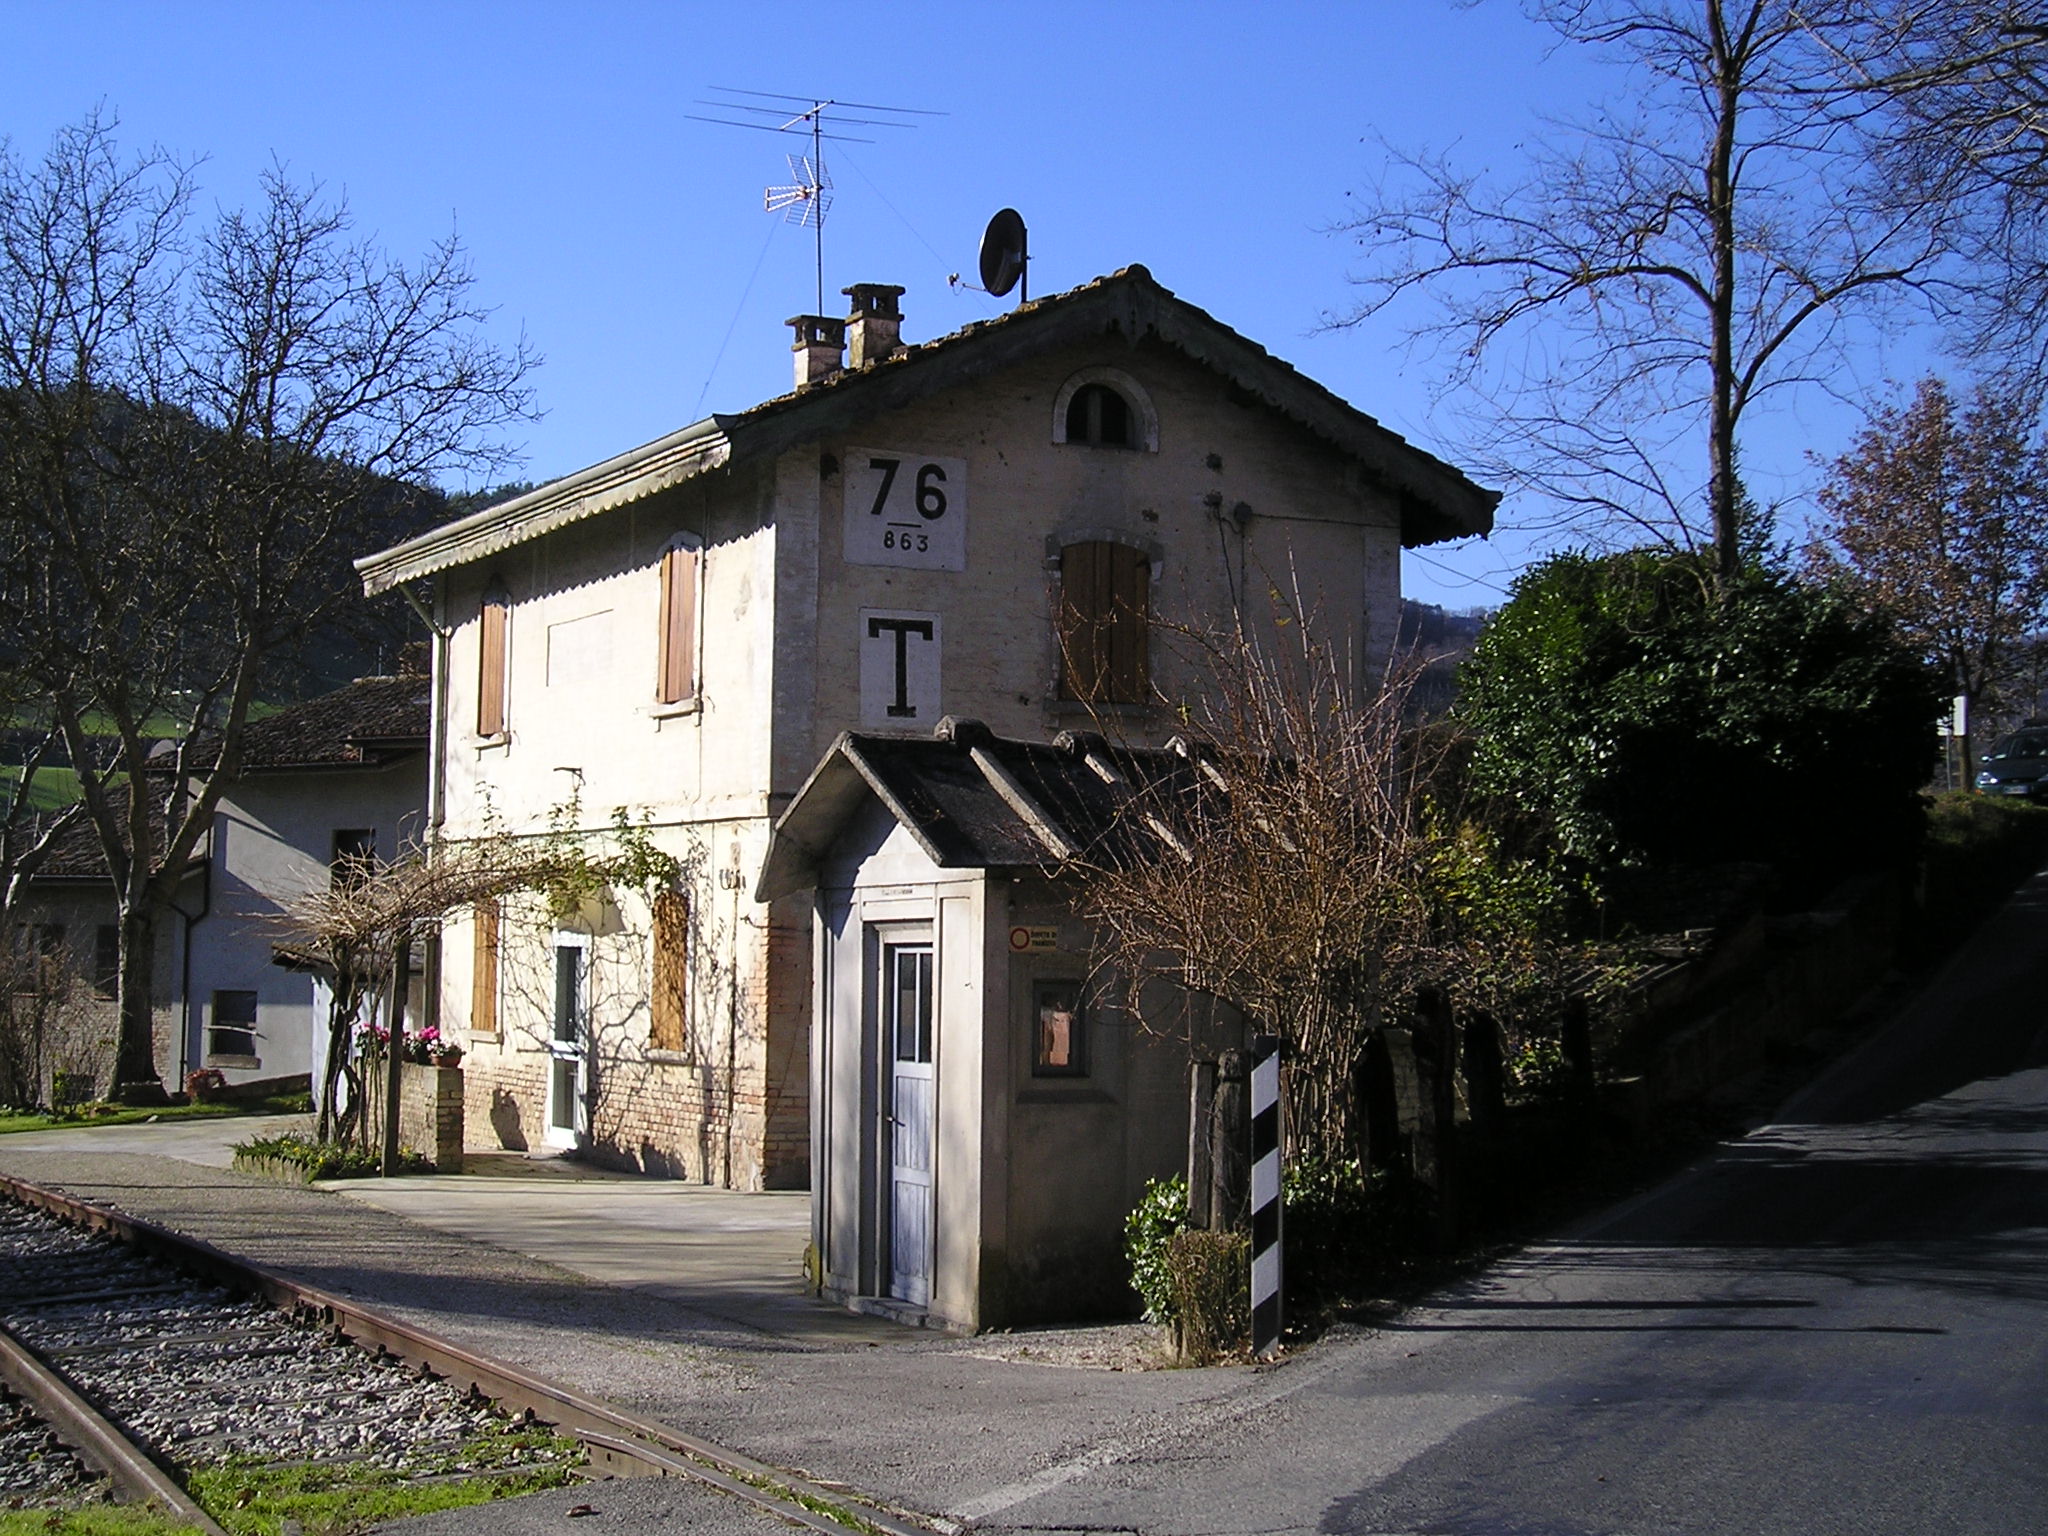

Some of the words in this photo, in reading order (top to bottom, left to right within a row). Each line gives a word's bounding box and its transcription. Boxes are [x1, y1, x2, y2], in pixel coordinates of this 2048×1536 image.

[869, 458, 947, 520] 76
[883, 530, 929, 553] 863
[868, 618, 933, 718] T
